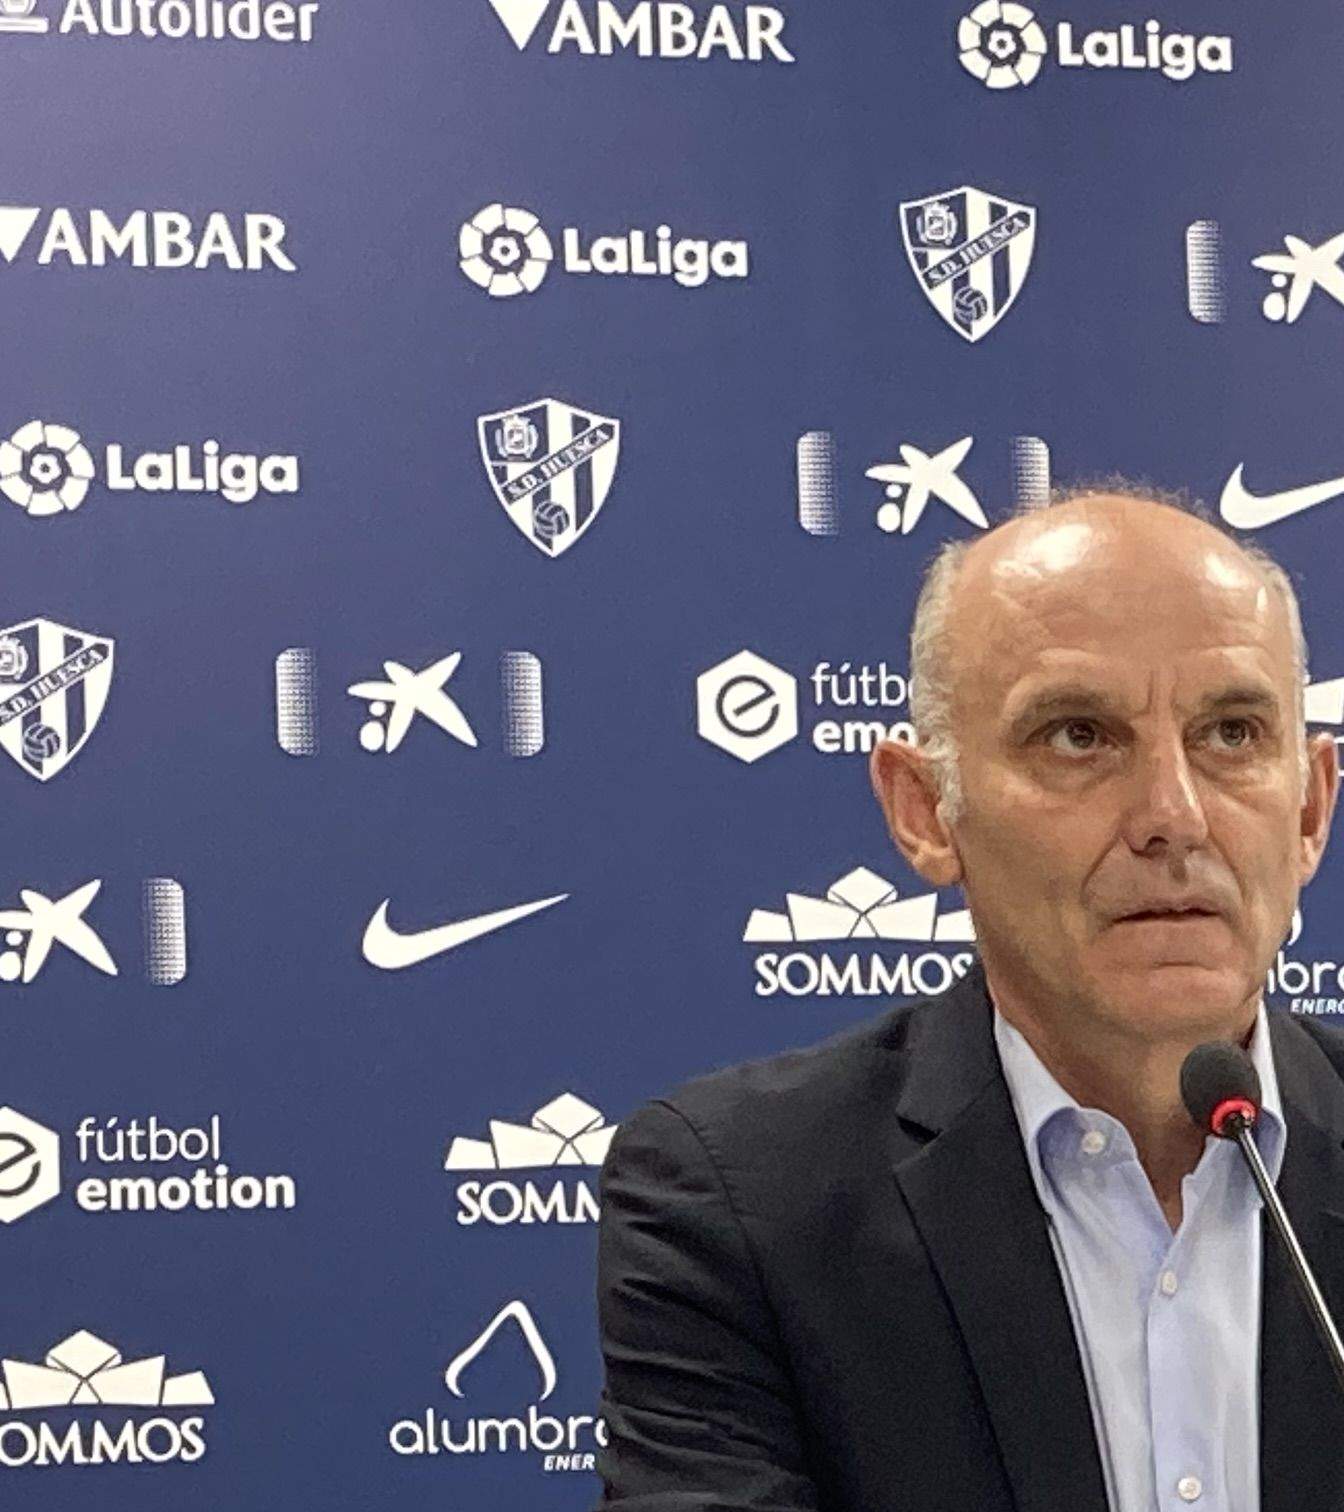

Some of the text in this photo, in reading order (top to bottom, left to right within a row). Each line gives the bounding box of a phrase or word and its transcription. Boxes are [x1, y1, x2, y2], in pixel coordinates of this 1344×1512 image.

[547, 0, 795, 62] AMBAR
[1057, 20, 1233, 80] LaLiga
[37, 207, 296, 271] AMBAR
[563, 224, 748, 287] LaLiga
[106, 440, 298, 503] LaLiga
[809, 661, 913, 706] fútb
[75, 1114, 220, 1162] fútbol
[76, 1164, 296, 1211] emotion
[456, 1180, 600, 1225] SOMM
[0, 1417, 206, 1467] OMMOS
[389, 1405, 608, 1454] alumbr
[543, 1453, 596, 1471] ENER
